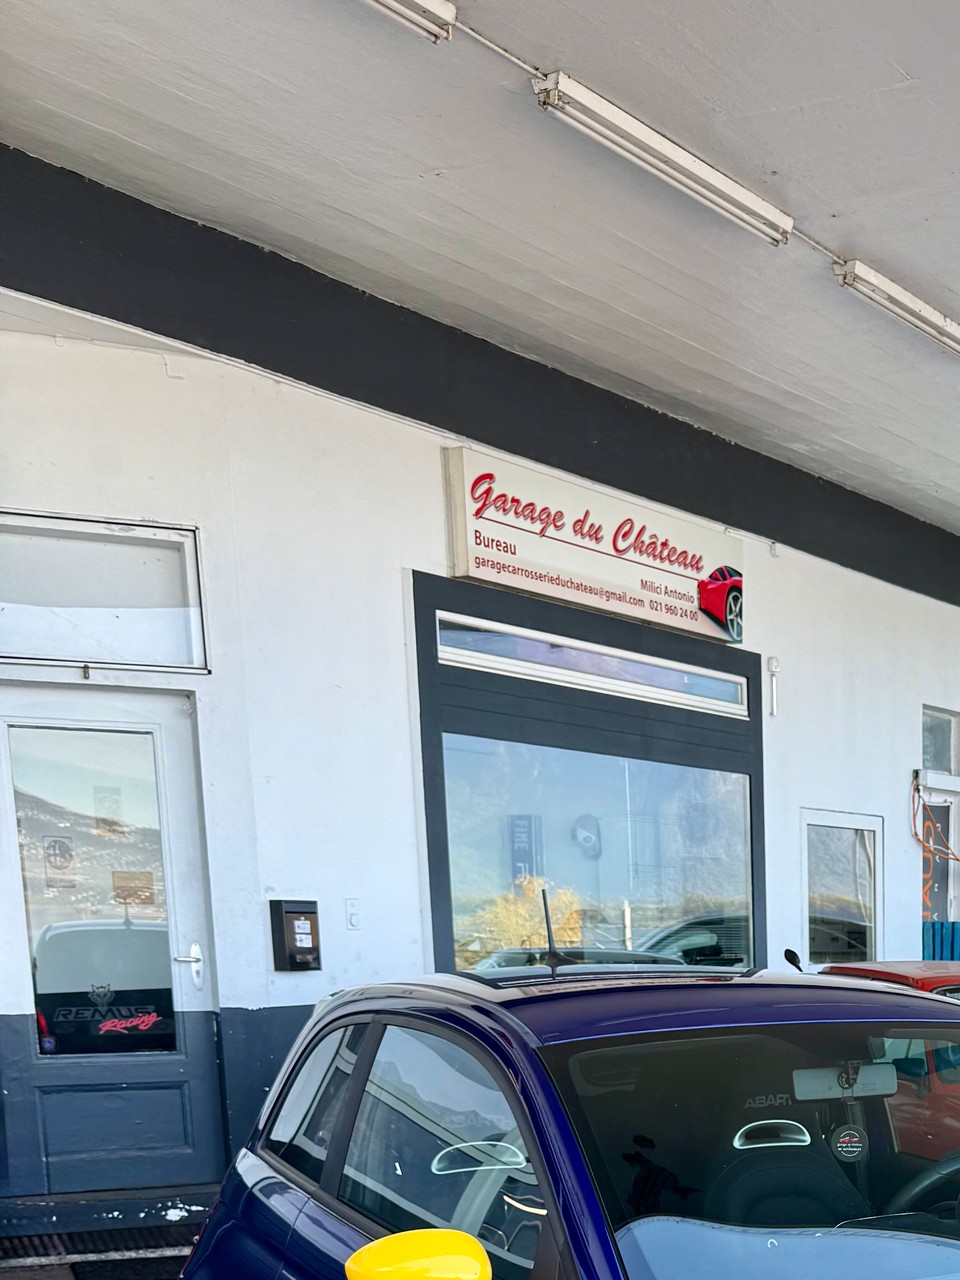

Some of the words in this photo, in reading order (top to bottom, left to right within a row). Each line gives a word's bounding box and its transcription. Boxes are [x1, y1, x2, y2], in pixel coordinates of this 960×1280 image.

[470, 472, 566, 537] Garage
[572, 509, 604, 544] du
[612, 518, 704, 573] Château
[474, 529, 517, 555] Bureau
[474, 555, 645, 608] garagecarrosserieduchateau@gmail.com
[640, 579, 662, 596] Milici
[664, 586, 695, 604] Antonio
[649, 599, 663, 612] 021
[664, 603, 678, 617] 960
[679, 608, 688, 619] 24
[689, 610, 699, 621] 00
[55, 1006, 155, 1020] REMUS
[98, 1012, 163, 1034] Racing
